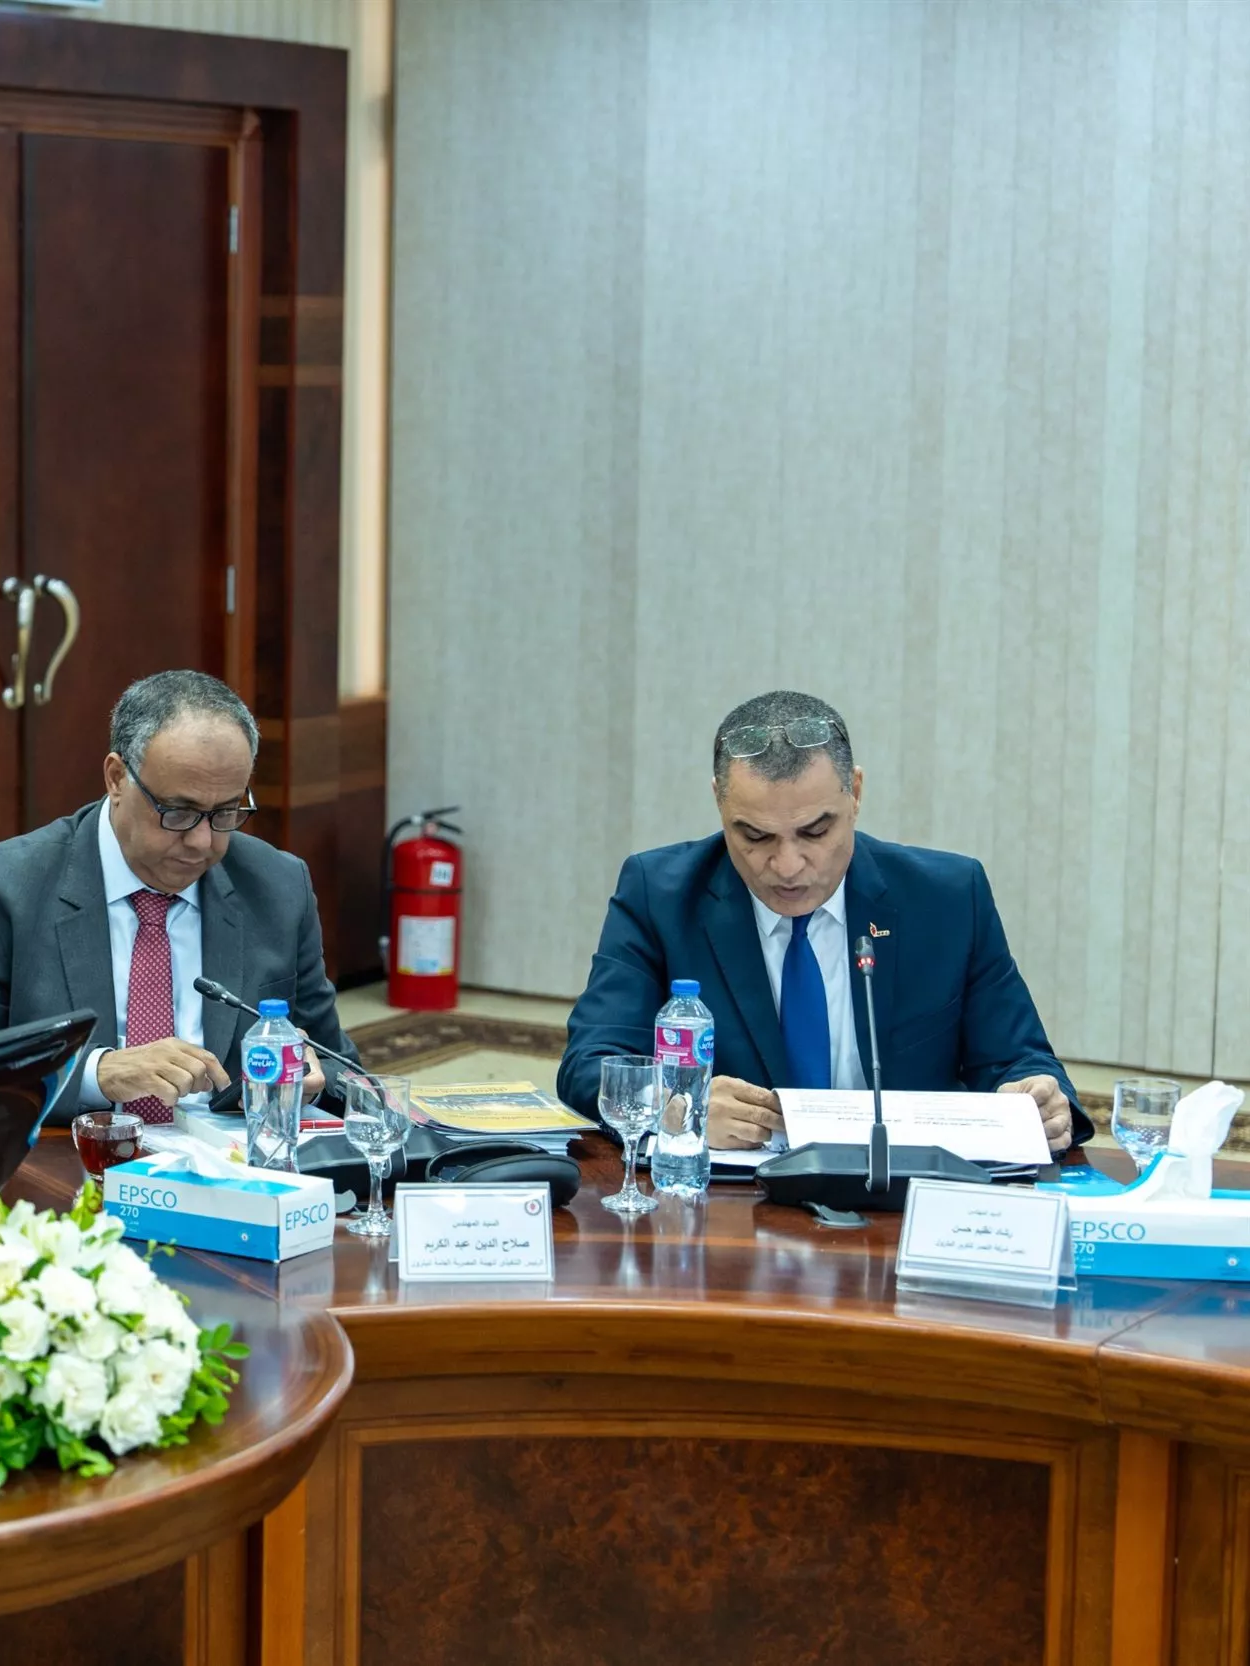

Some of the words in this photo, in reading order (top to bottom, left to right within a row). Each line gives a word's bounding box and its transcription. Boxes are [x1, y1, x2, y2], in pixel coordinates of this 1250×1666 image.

[118, 1183, 178, 1209] EPSCO
[119, 1205, 140, 1218] 270
[284, 1202, 330, 1231] EPSCO
[1070, 1220, 1146, 1241] EPSCO
[424, 1238, 450, 1253] الكريم
[454, 1239, 470, 1251] عبد
[475, 1238, 498, 1251] الدين
[502, 1238, 530, 1252] صلاح
